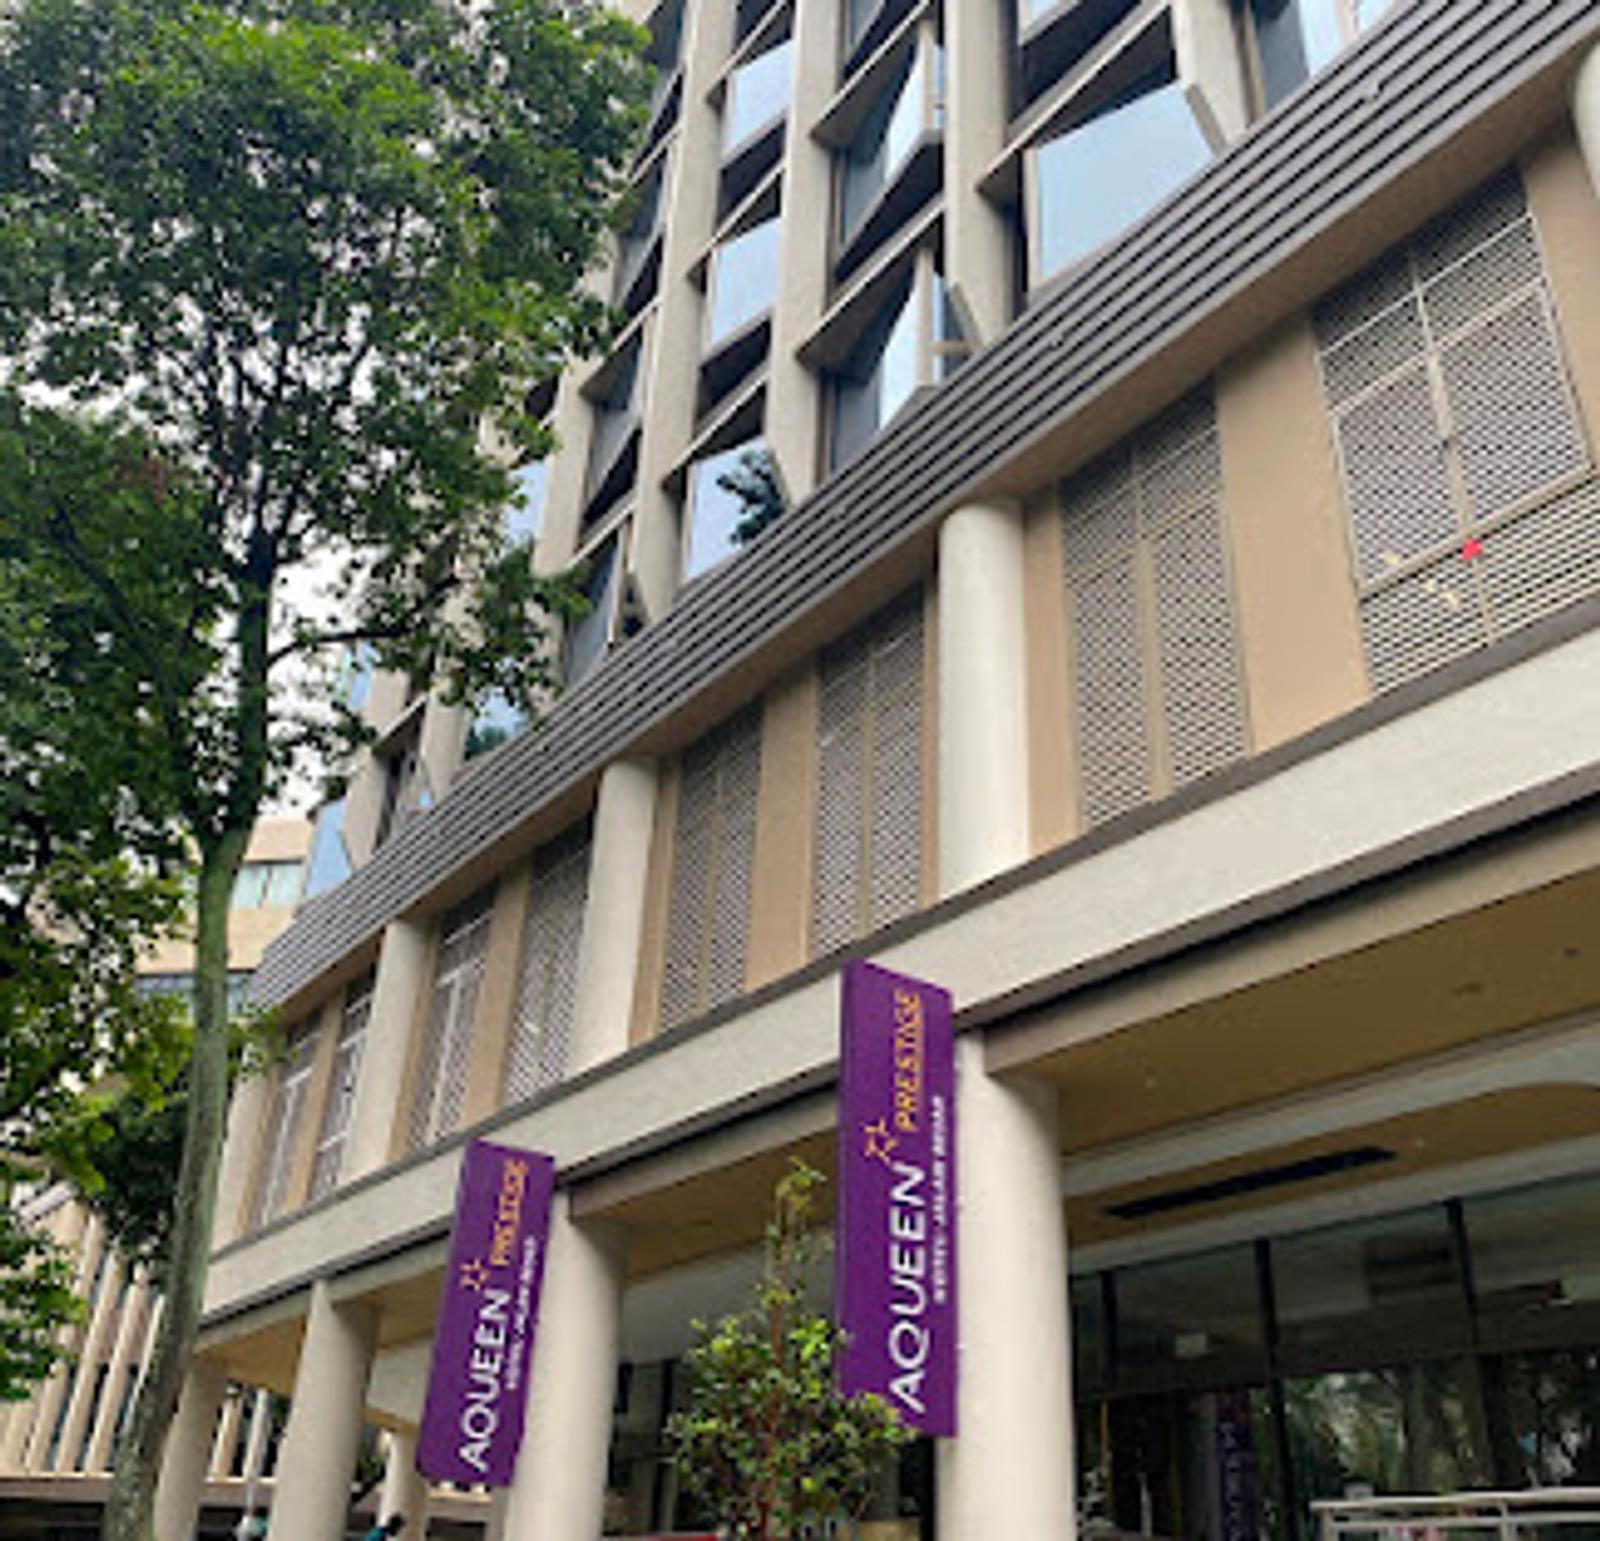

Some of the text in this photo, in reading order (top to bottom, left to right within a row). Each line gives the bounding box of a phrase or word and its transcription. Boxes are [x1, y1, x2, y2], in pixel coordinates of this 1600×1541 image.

[894, 988, 922, 1132] PRESTIGE
[490, 1159, 529, 1266] PRESTIGE
[889, 1161, 930, 1413] AQUEEN
[459, 1288, 512, 1473] AQUEEN
